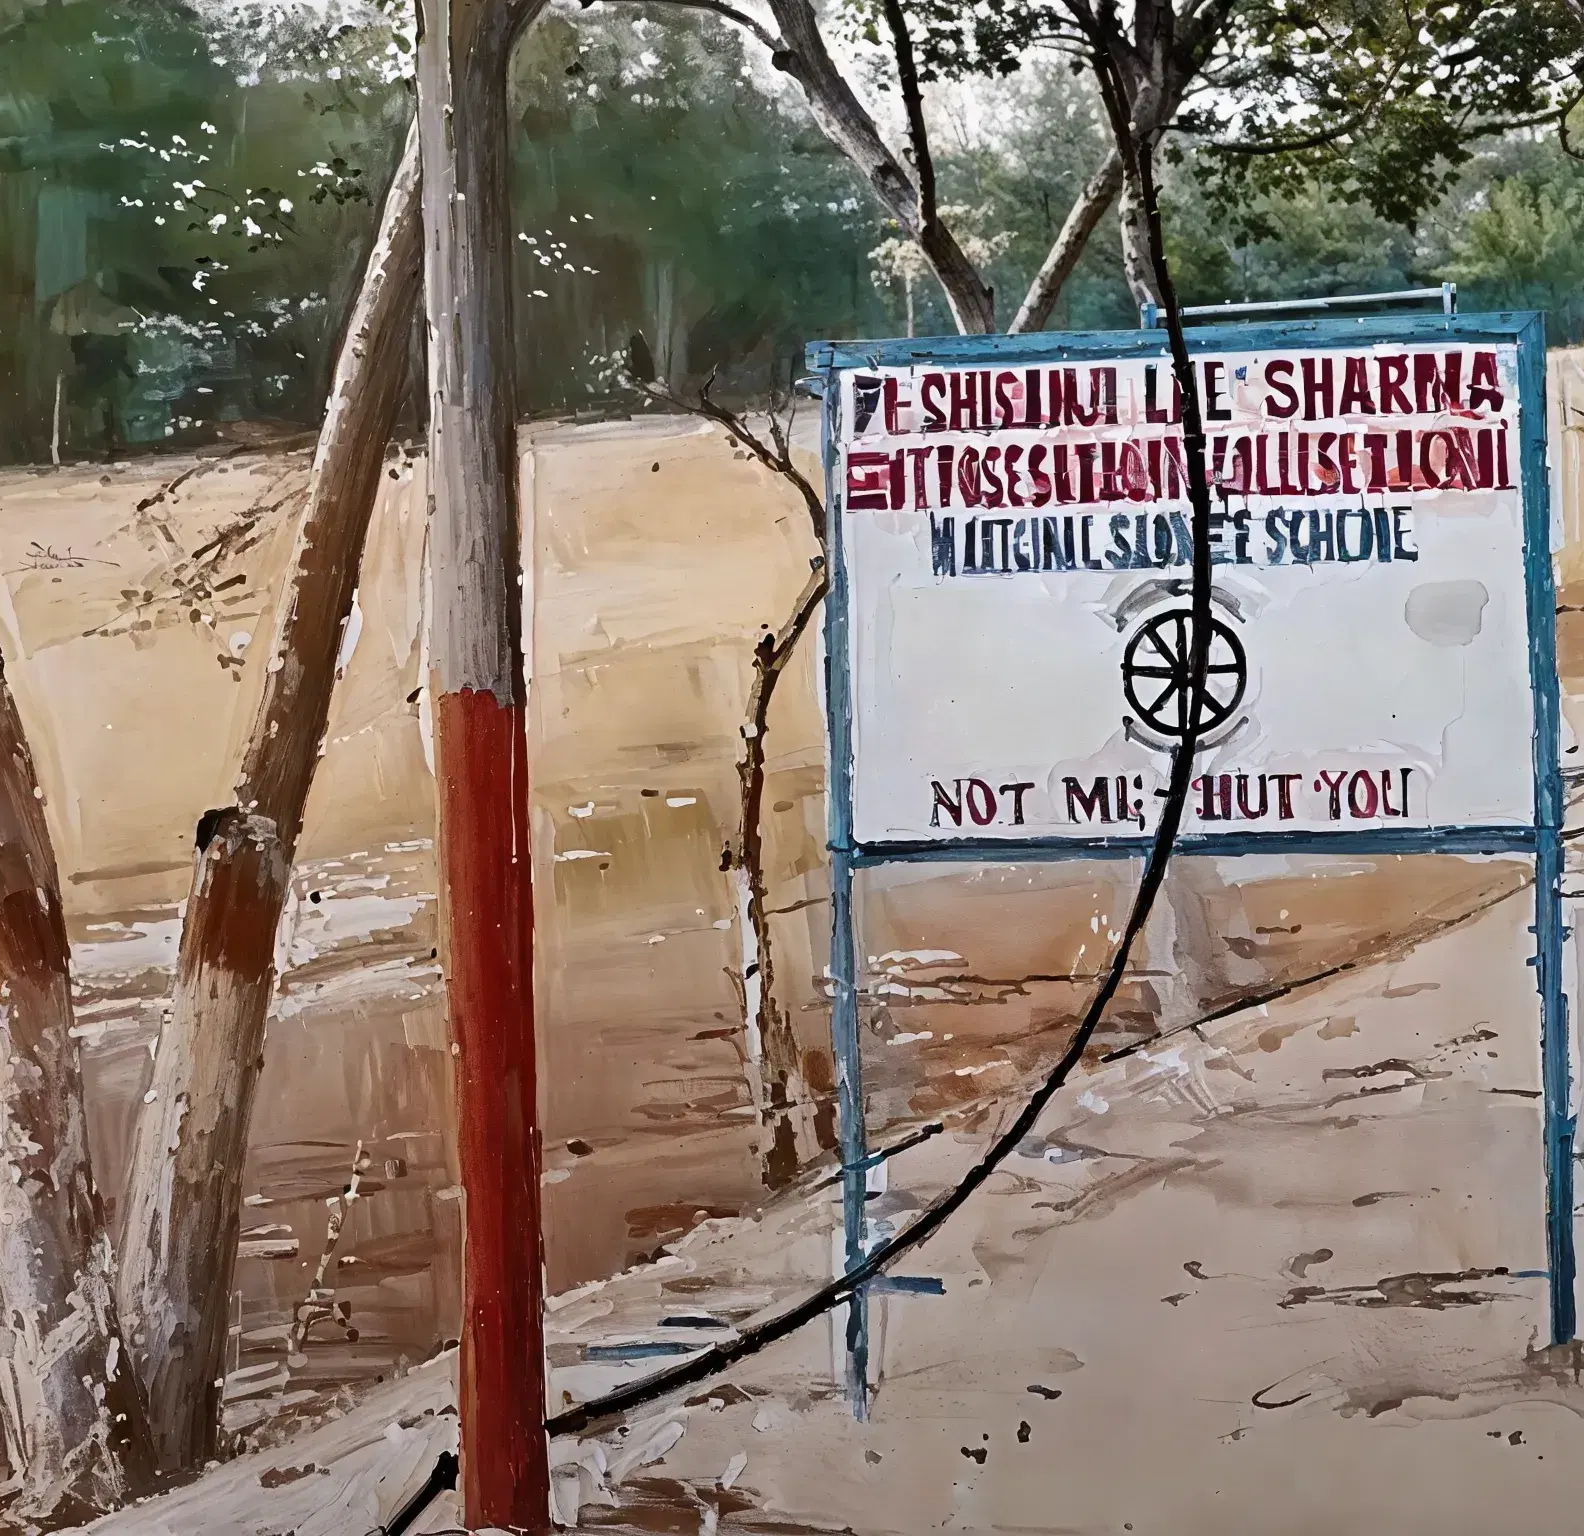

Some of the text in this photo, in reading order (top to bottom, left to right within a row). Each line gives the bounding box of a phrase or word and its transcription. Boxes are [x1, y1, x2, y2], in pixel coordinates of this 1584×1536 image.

[1264, 351, 1504, 420] SHARMA
[929, 777, 1035, 827] NOT
[1313, 767, 1413, 821] YOU
